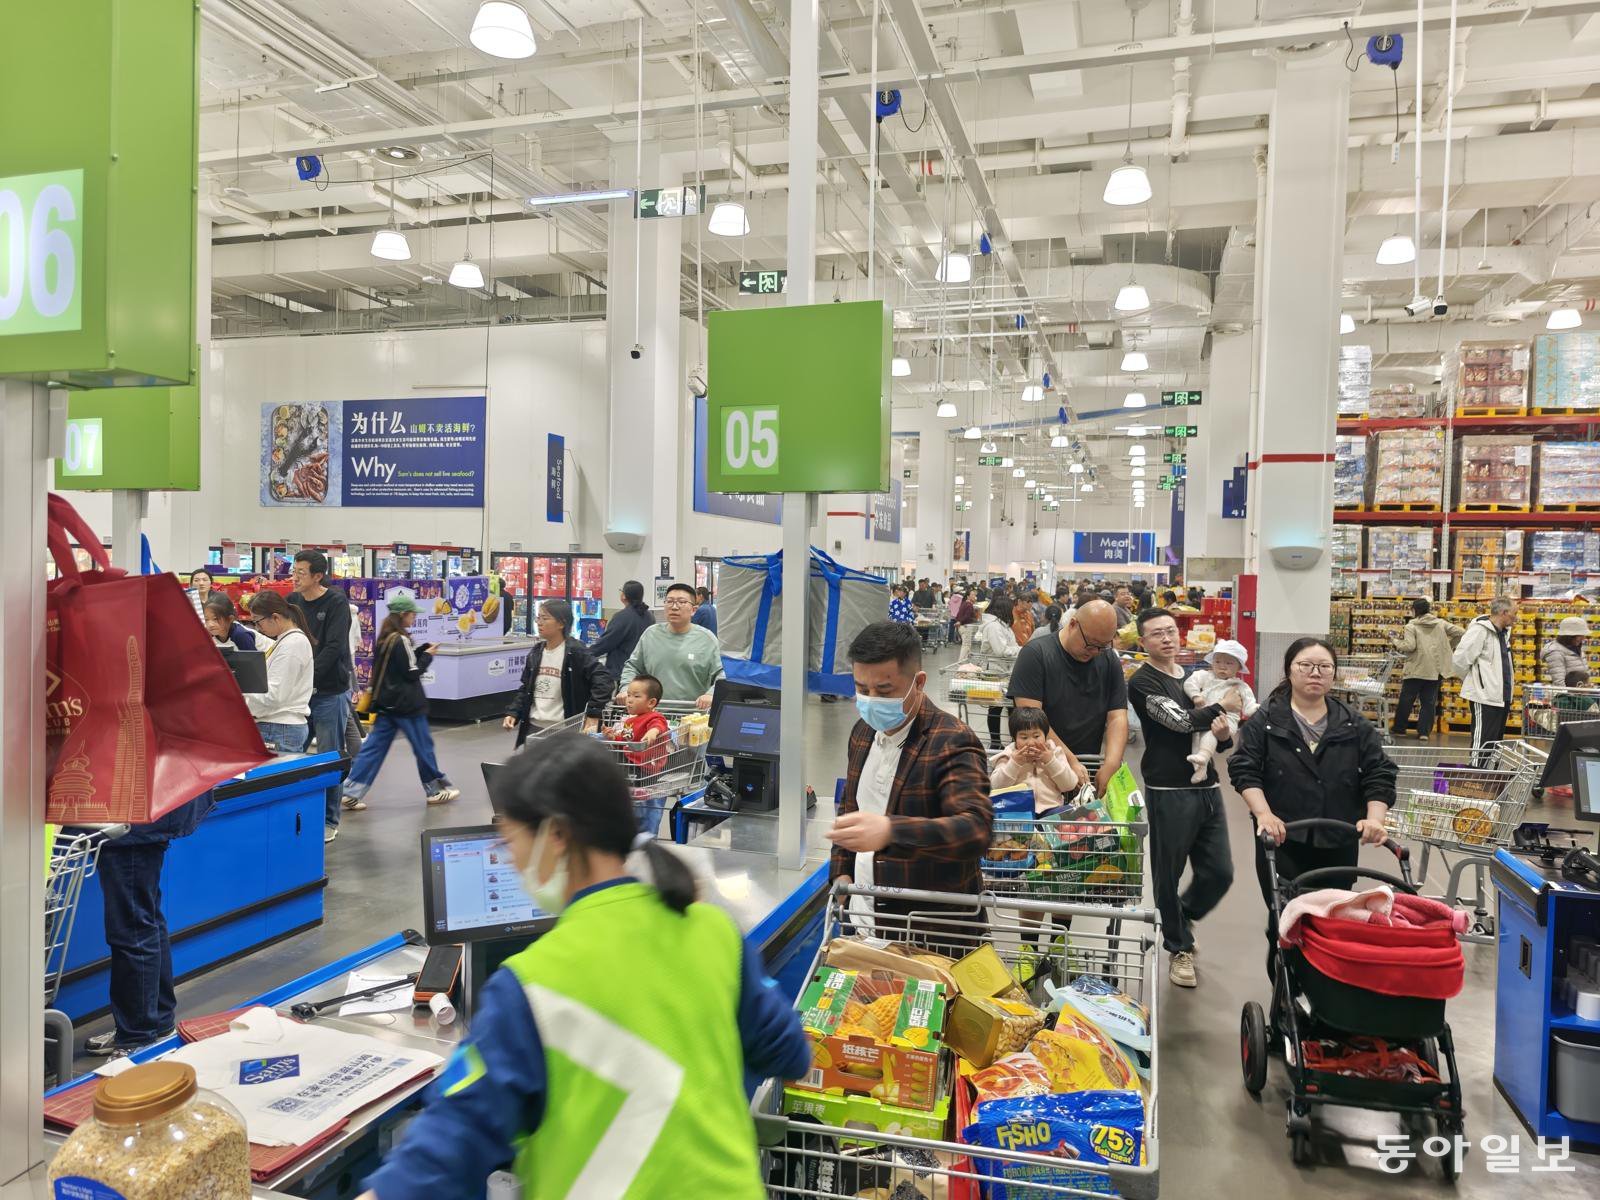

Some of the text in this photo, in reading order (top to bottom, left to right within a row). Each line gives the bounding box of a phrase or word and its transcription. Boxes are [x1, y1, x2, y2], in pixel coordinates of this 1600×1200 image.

[351, 411, 406, 434] 为什么
[65, 423, 99, 470] 07
[726, 410, 779, 469] 05
[351, 456, 397, 483] Why
[1100, 537, 1130, 548] Meat
[244, 1057, 297, 1084] Sam's
[1094, 1145, 1133, 1165] fish meat
